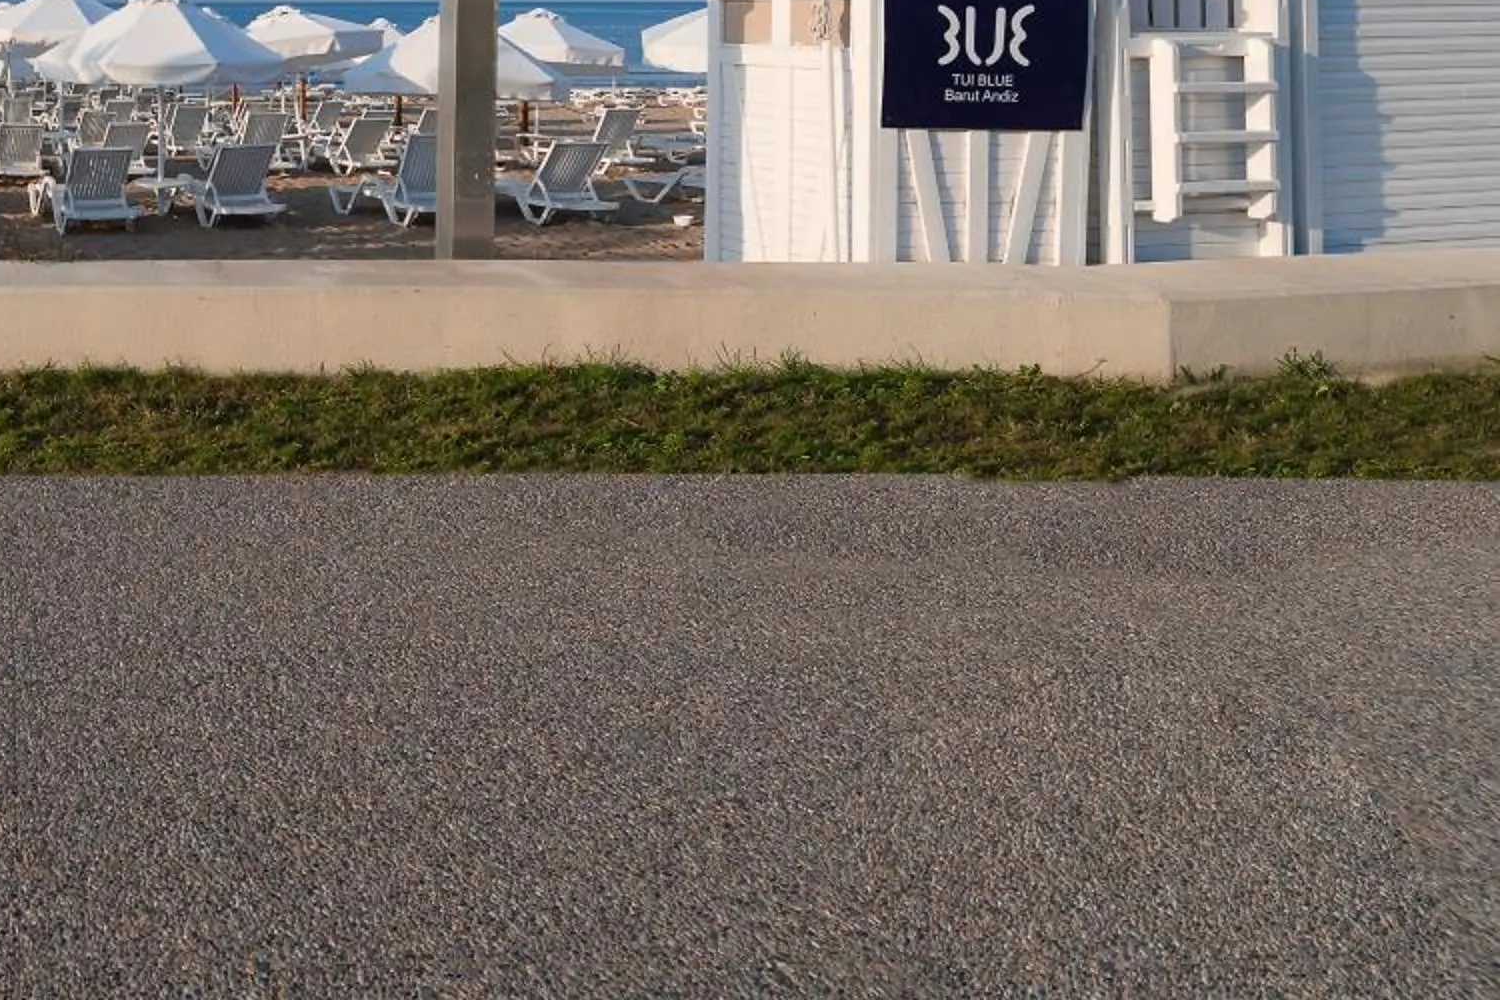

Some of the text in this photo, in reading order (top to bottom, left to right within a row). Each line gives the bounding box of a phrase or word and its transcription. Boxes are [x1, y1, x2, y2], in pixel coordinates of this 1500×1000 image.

[952, 73, 1013, 87] TUI BLUE
[944, 88, 980, 102] Barut
